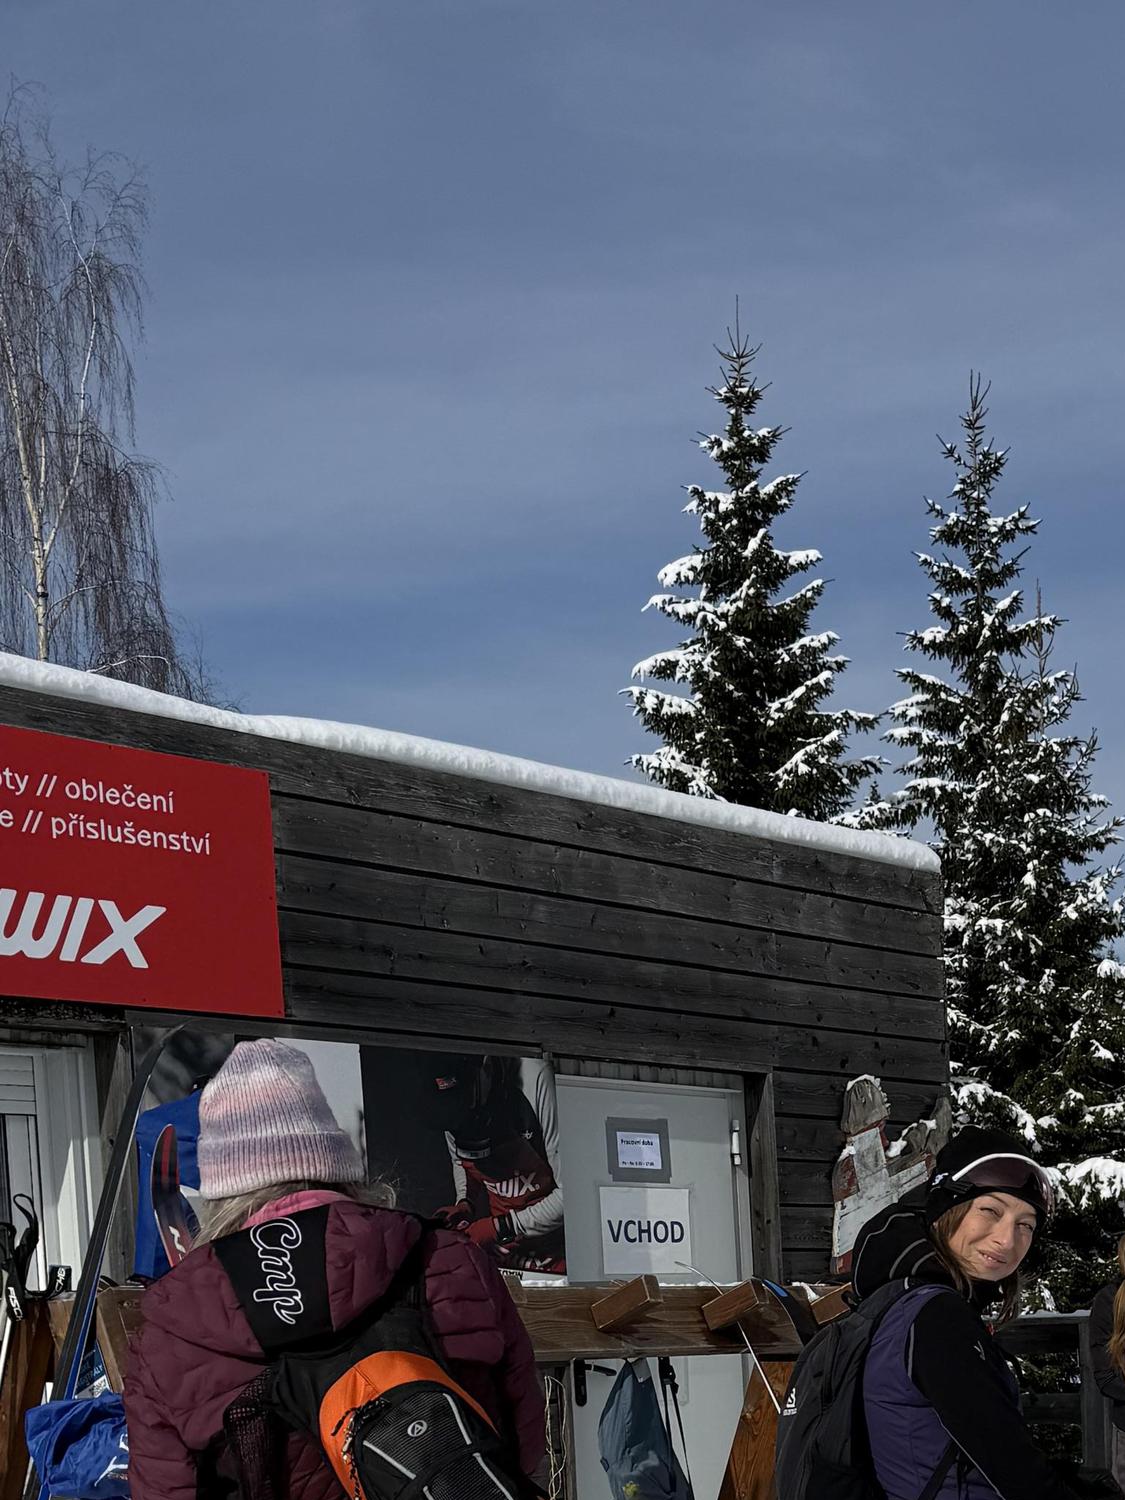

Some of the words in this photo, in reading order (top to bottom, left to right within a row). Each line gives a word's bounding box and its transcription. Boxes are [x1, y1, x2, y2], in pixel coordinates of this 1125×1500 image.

[0, 767, 29, 796] ty
[64, 777, 175, 814] oblečení
[51, 812, 211, 856] příslušenství
[607, 1219, 685, 1244] VCHOD
